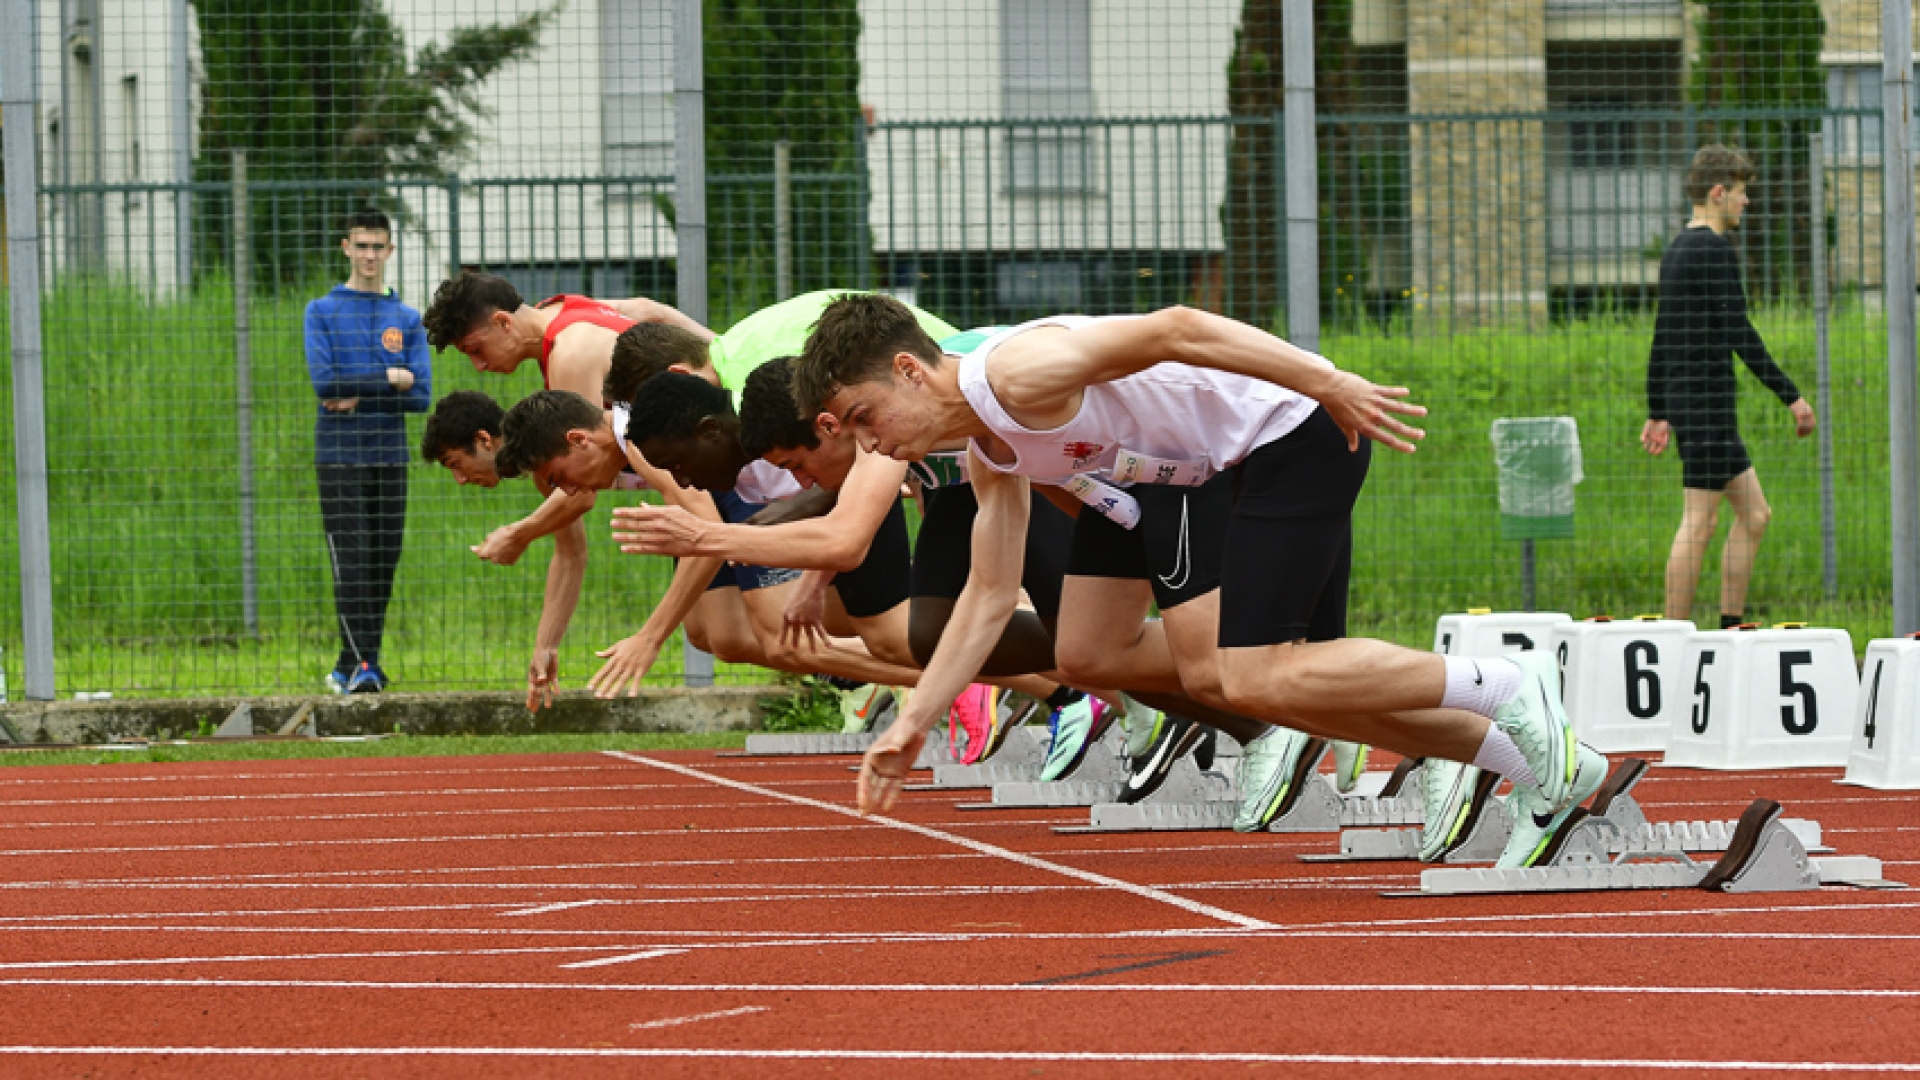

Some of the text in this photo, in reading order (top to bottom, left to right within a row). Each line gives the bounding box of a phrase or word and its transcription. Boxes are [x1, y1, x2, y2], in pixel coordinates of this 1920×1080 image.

[1624, 639, 1662, 719] 6
[1691, 649, 1715, 735] 5
[1779, 649, 1819, 735] 5
[1863, 657, 1885, 750] 4
